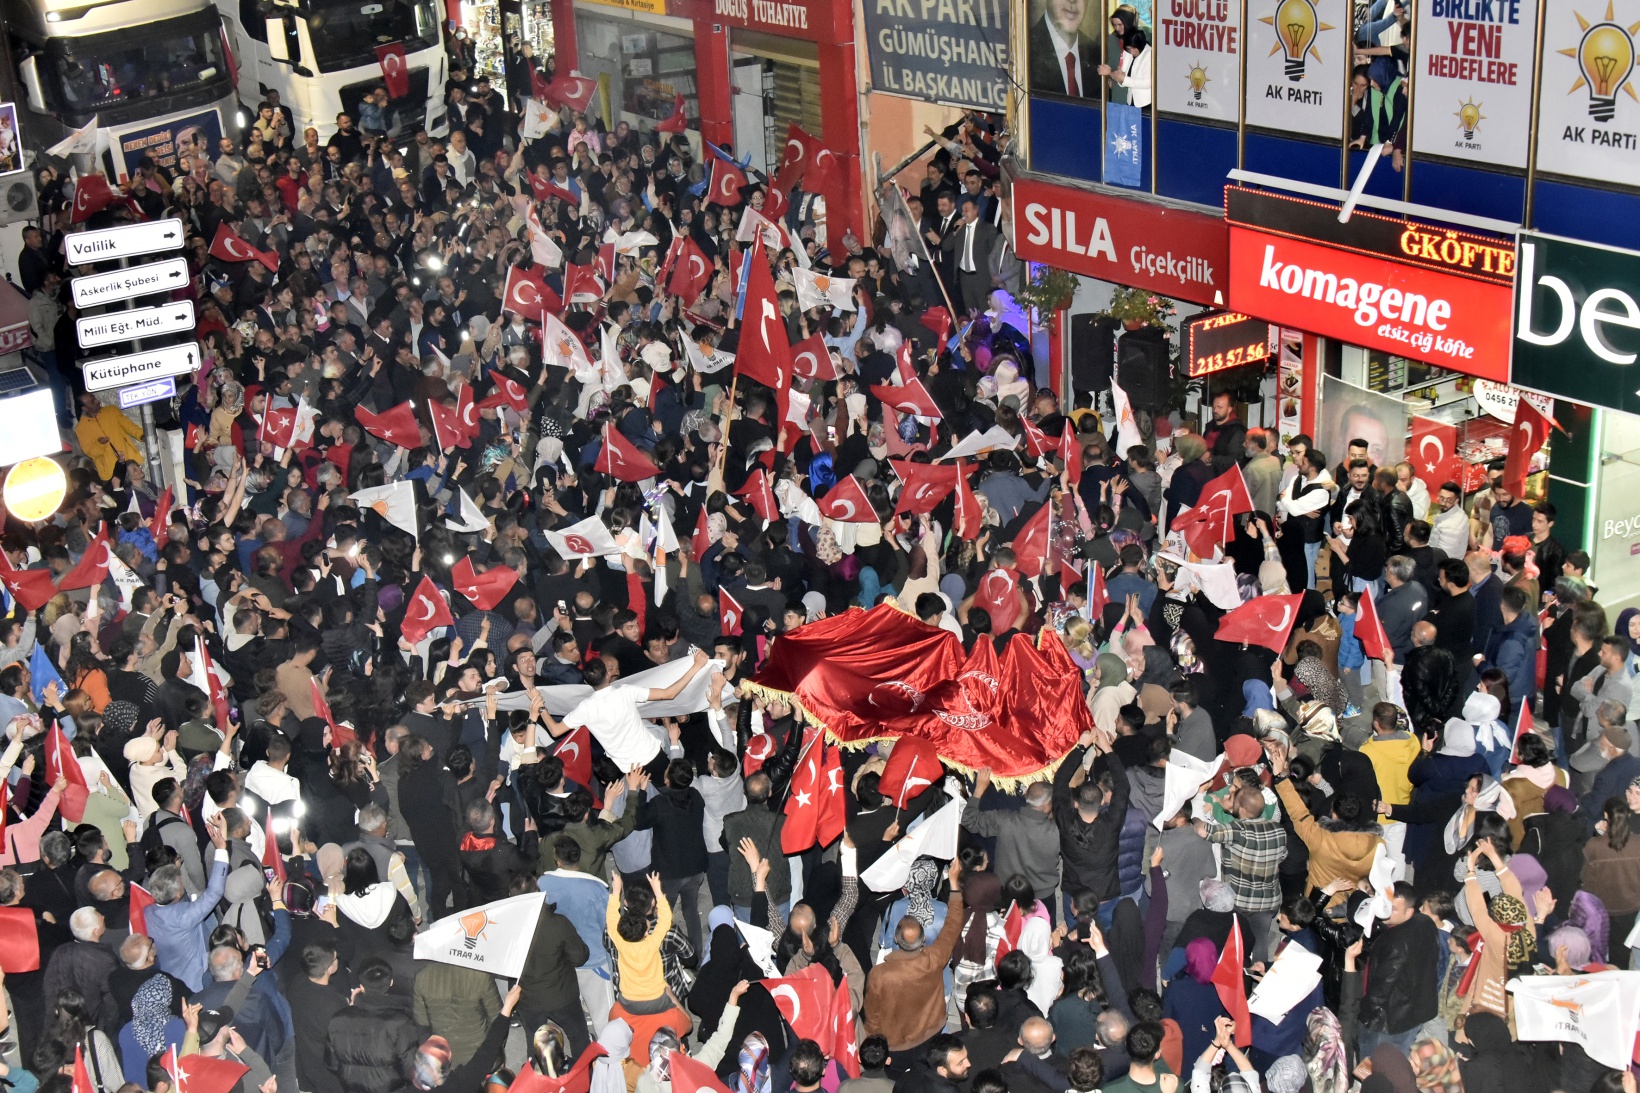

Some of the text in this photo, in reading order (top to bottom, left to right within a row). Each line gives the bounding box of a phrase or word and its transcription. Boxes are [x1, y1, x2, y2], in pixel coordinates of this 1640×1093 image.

[752, 0, 808, 30] TUHAFİYE
[876, 0, 916, 19] AK
[879, 24, 1009, 69] GÜMÜŞHANE
[1162, 19, 1237, 54] TÜRKİYE
[1448, 20, 1502, 59] YENİ
[882, 61, 1009, 107] İL BAŞKANLIĞ
[1428, 54, 1518, 86] HEDEFLERE
[1265, 84, 1284, 100] AK
[1454, 141, 1463, 149] AK
[1562, 125, 1586, 142] AK
[73, 239, 116, 254] Valilik
[1024, 202, 1214, 285] SILA Çiçekçilik
[80, 273, 159, 298] Askerlik Şubesi
[1259, 244, 1452, 331] komagene
[1516, 243, 1640, 366] be
[84, 316, 164, 338] Milli Eğt. Müd.
[1377, 324, 1475, 359] etsiz çiğ köfte
[90, 360, 162, 381] Kütüphane
[1197, 342, 1265, 373] 213 57 56
[1486, 392, 1506, 404] 0456
